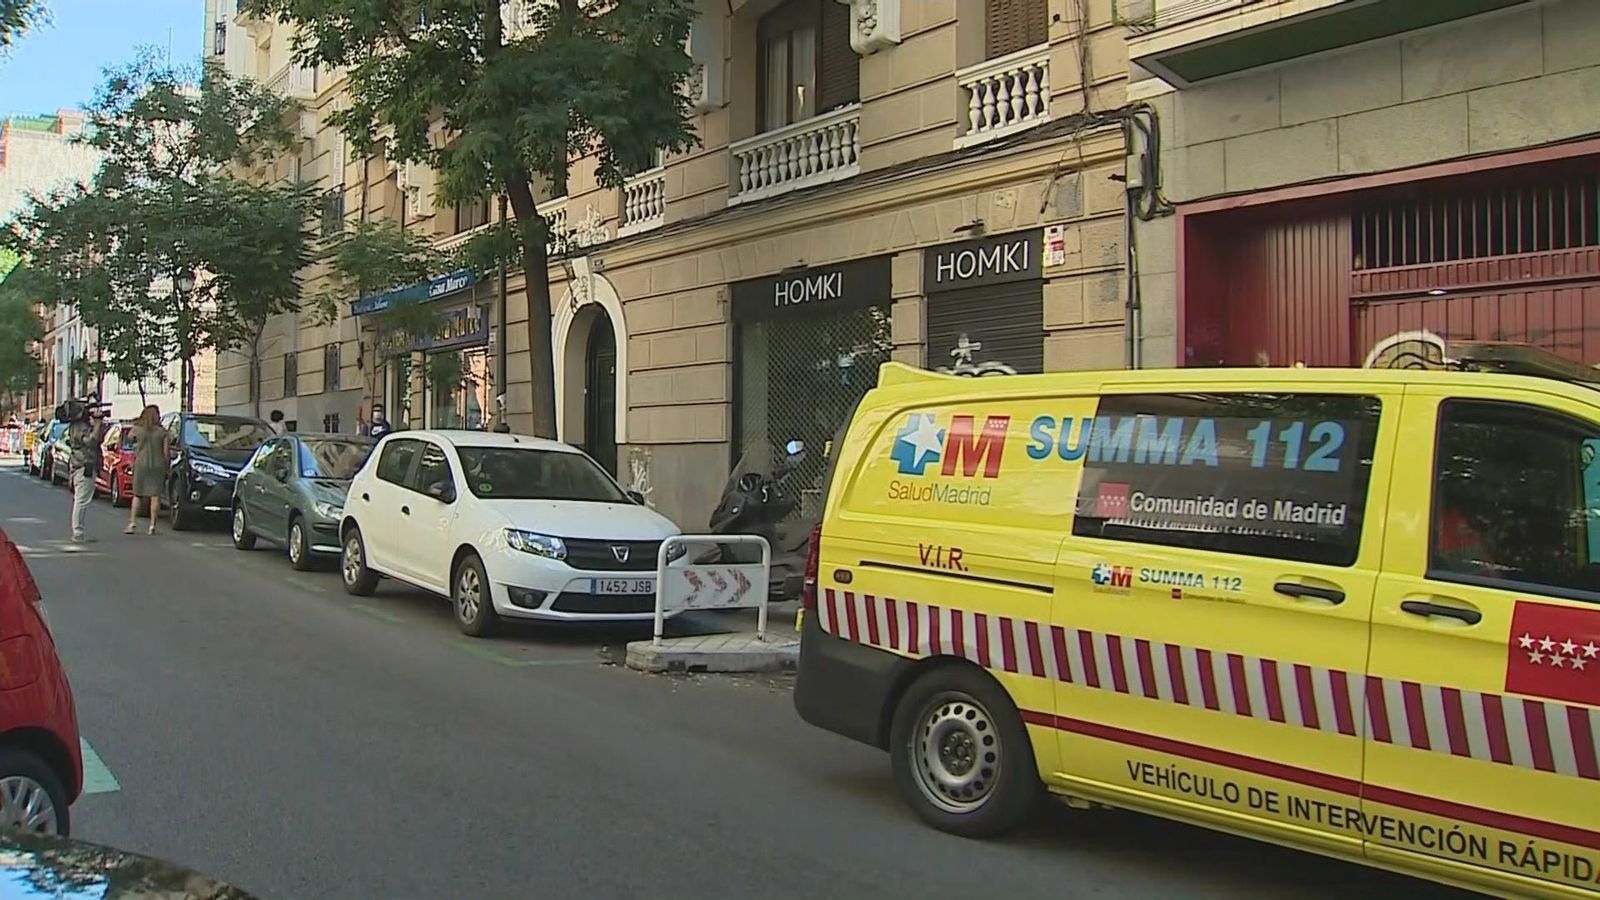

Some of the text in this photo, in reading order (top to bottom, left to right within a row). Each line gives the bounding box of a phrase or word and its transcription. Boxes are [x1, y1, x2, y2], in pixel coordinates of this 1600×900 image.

[936, 240, 1031, 282] HOMKI
[774, 272, 843, 306] HOMKI
[941, 415, 1011, 479] M
[1026, 415, 1346, 473] SUMMA 112
[887, 480, 992, 506] SaludMadrid
[1130, 491, 1347, 526] Comunidad de Madrid
[918, 543, 969, 572] V.I.R.
[600, 580, 652, 593] 1452 JSB
[1139, 568, 1242, 591] SUMMA 112
[1127, 759, 1600, 885] VEHÍCULO DE INTERVENCIÓN RÁPID
